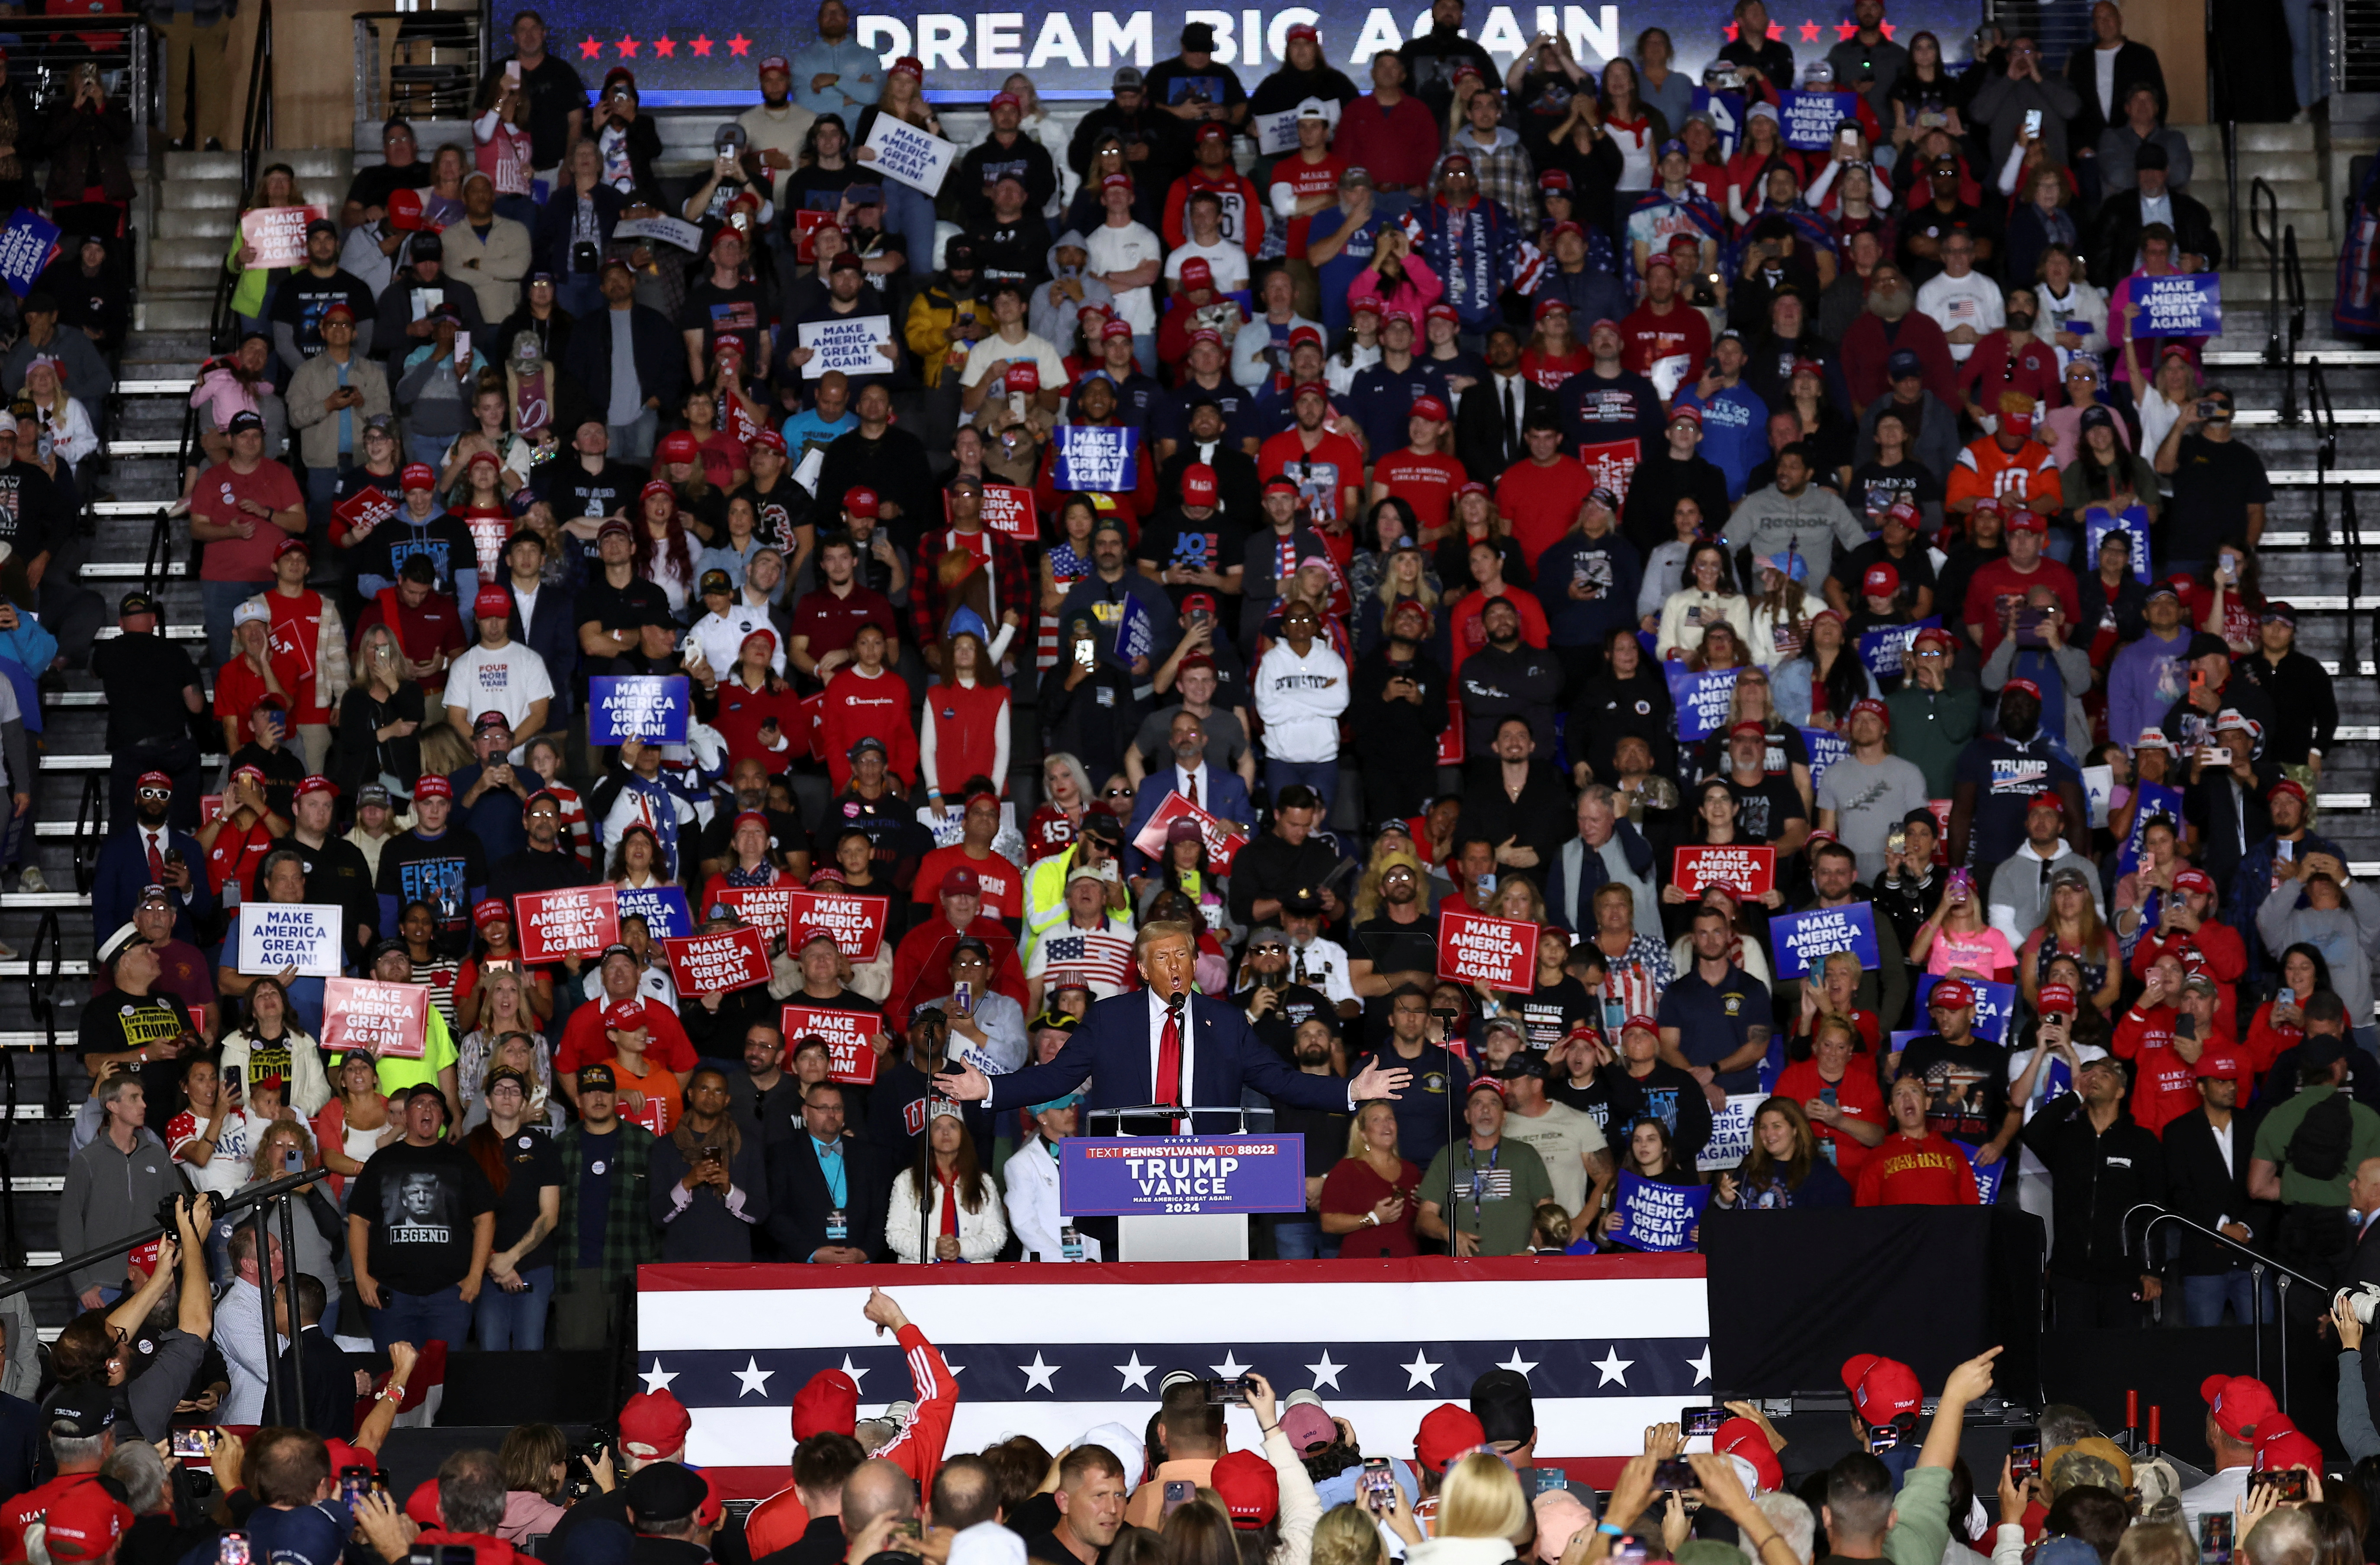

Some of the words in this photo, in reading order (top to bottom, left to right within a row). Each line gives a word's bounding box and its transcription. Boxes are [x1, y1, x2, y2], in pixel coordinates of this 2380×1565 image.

[856, 11, 1153, 70] DREAM
[1795, 97, 1833, 109] MAKE
[1785, 107, 1845, 119] AMERICA
[1791, 119, 1837, 130] GREAT
[896, 128, 932, 149] MAKE
[1790, 130, 1833, 141] AGAIN
[880, 134, 936, 165] AMERICA
[883, 148, 925, 170] GREAT
[878, 157, 923, 180] AGAIN!
[264, 212, 304, 224] MAKE
[254, 223, 307, 237] AMERIC
[1, 223, 32, 280] AMERICA
[13, 233, 36, 278] GREAT
[263, 247, 308, 260] AGAIN
[2153, 280, 2195, 292] MAKE
[2141, 291, 2208, 306] AMERICA
[2150, 303, 2200, 317] GREAT
[824, 324, 863, 335] MAKE
[2150, 317, 2201, 329] AGAIN!
[813, 334, 878, 346] AMERICA
[822, 344, 868, 356] GREAT
[821, 356, 871, 368] AGAIN!
[1074, 433, 1116, 445] MAKE
[1061, 445, 1129, 457] AMERICA
[1069, 457, 1119, 469] GREAT
[980, 511, 1016, 520] REAT
[990, 521, 1019, 531] AIN!
[1760, 517, 1829, 529] Reebok
[474, 537, 507, 548] ERIC
[616, 683, 662, 696] MAKE
[1700, 675, 1737, 691] MAK
[601, 697, 675, 710] AMERICA
[846, 695, 894, 707] Champion
[1689, 690, 1731, 706] AMER
[611, 710, 665, 723] GREAT
[1698, 705, 1729, 717] GRE
[610, 723, 666, 736] AGAIN!
[1816, 737, 1847, 752] AIN!
[1991, 759, 2048, 772] TRUMP
[945, 814, 964, 823] MA
[1042, 820, 1070, 844] 45
[1701, 851, 1749, 860] MAKE
[401, 864, 466, 880] FIGHT
[1686, 860, 1762, 871] AMERICA
[1695, 871, 1752, 881] GREAT
[1693, 881, 1751, 893] AN!
[542, 895, 589, 910] MAKE
[743, 891, 789, 903] MAKE
[814, 899, 862, 914] MAKE
[268, 912, 312, 924] MAKE
[530, 907, 605, 927] AMERICA
[800, 913, 873, 929] AMERICA
[1798, 913, 1845, 932] MAKE
[253, 926, 326, 938] AMERICA
[541, 921, 596, 939] GREAT
[650, 927, 671, 938] IN!
[834, 929, 863, 942] EAT
[1464, 921, 1512, 939] MAKE
[1786, 926, 1862, 948] AMERICA
[263, 939, 316, 951] GREAT
[542, 935, 599, 953] AGAIN!
[688, 937, 735, 954] MAKE
[842, 942, 859, 955] IN!
[1449, 935, 1523, 956] AMERICA
[1797, 939, 1853, 958] GREAT
[261, 953, 317, 965] AGAIN!
[680, 945, 753, 967] AMERICA
[1457, 949, 1513, 967] GREAT
[691, 960, 744, 978] GREAT
[1455, 963, 1512, 982] AGAIN!
[695, 970, 750, 990] AGAIN!
[352, 987, 401, 1003] MAKE
[337, 1000, 414, 1019] AMERICA
[616, 1005, 629, 1013] MAKE
[1524, 1003, 1563, 1015] LEBANESE
[346, 1015, 402, 1031] GREAT
[808, 1015, 854, 1031] MAKE
[132, 1023, 180, 1039] TRUMP
[343, 1030, 402, 1045] AGAIN!
[830, 1045, 857, 1059] EAT
[961, 1049, 1001, 1075] AMER
[253, 1064, 291, 1079] TRUM
[932, 1101, 958, 1116] USA
[1716, 1104, 1743, 1116] AKE
[1712, 1118, 1754, 1131] ERICA
[1710, 1131, 1747, 1145] REAT
[1089, 1148, 1119, 1158] TEXT
[1122, 1146, 1215, 1157] PENNSYLVANIA
[1219, 1146, 1235, 1155] TO
[1238, 1145, 1276, 1155] 88022
[1126, 1157, 1238, 1179] TRUMP
[1139, 1178, 1226, 1195] VANCE
[1638, 1186, 1685, 1205] MAKE
[1165, 1203, 1200, 1214] 2024
[1626, 1195, 1694, 1219] AMERICA
[1632, 1213, 1685, 1232] GREAT
[392, 1229, 449, 1244] LEGEND
[1629, 1224, 1683, 1246] AGAIN!
[145, 1245, 158, 1253] MAKE
[148, 1254, 158, 1262] GRE
[1894, 1399, 1914, 1409] TRUMP
[55, 1408, 82, 1419] TRUMP
[1303, 1430, 1317, 1439] BORO
[19, 1508, 46, 1525] MA
